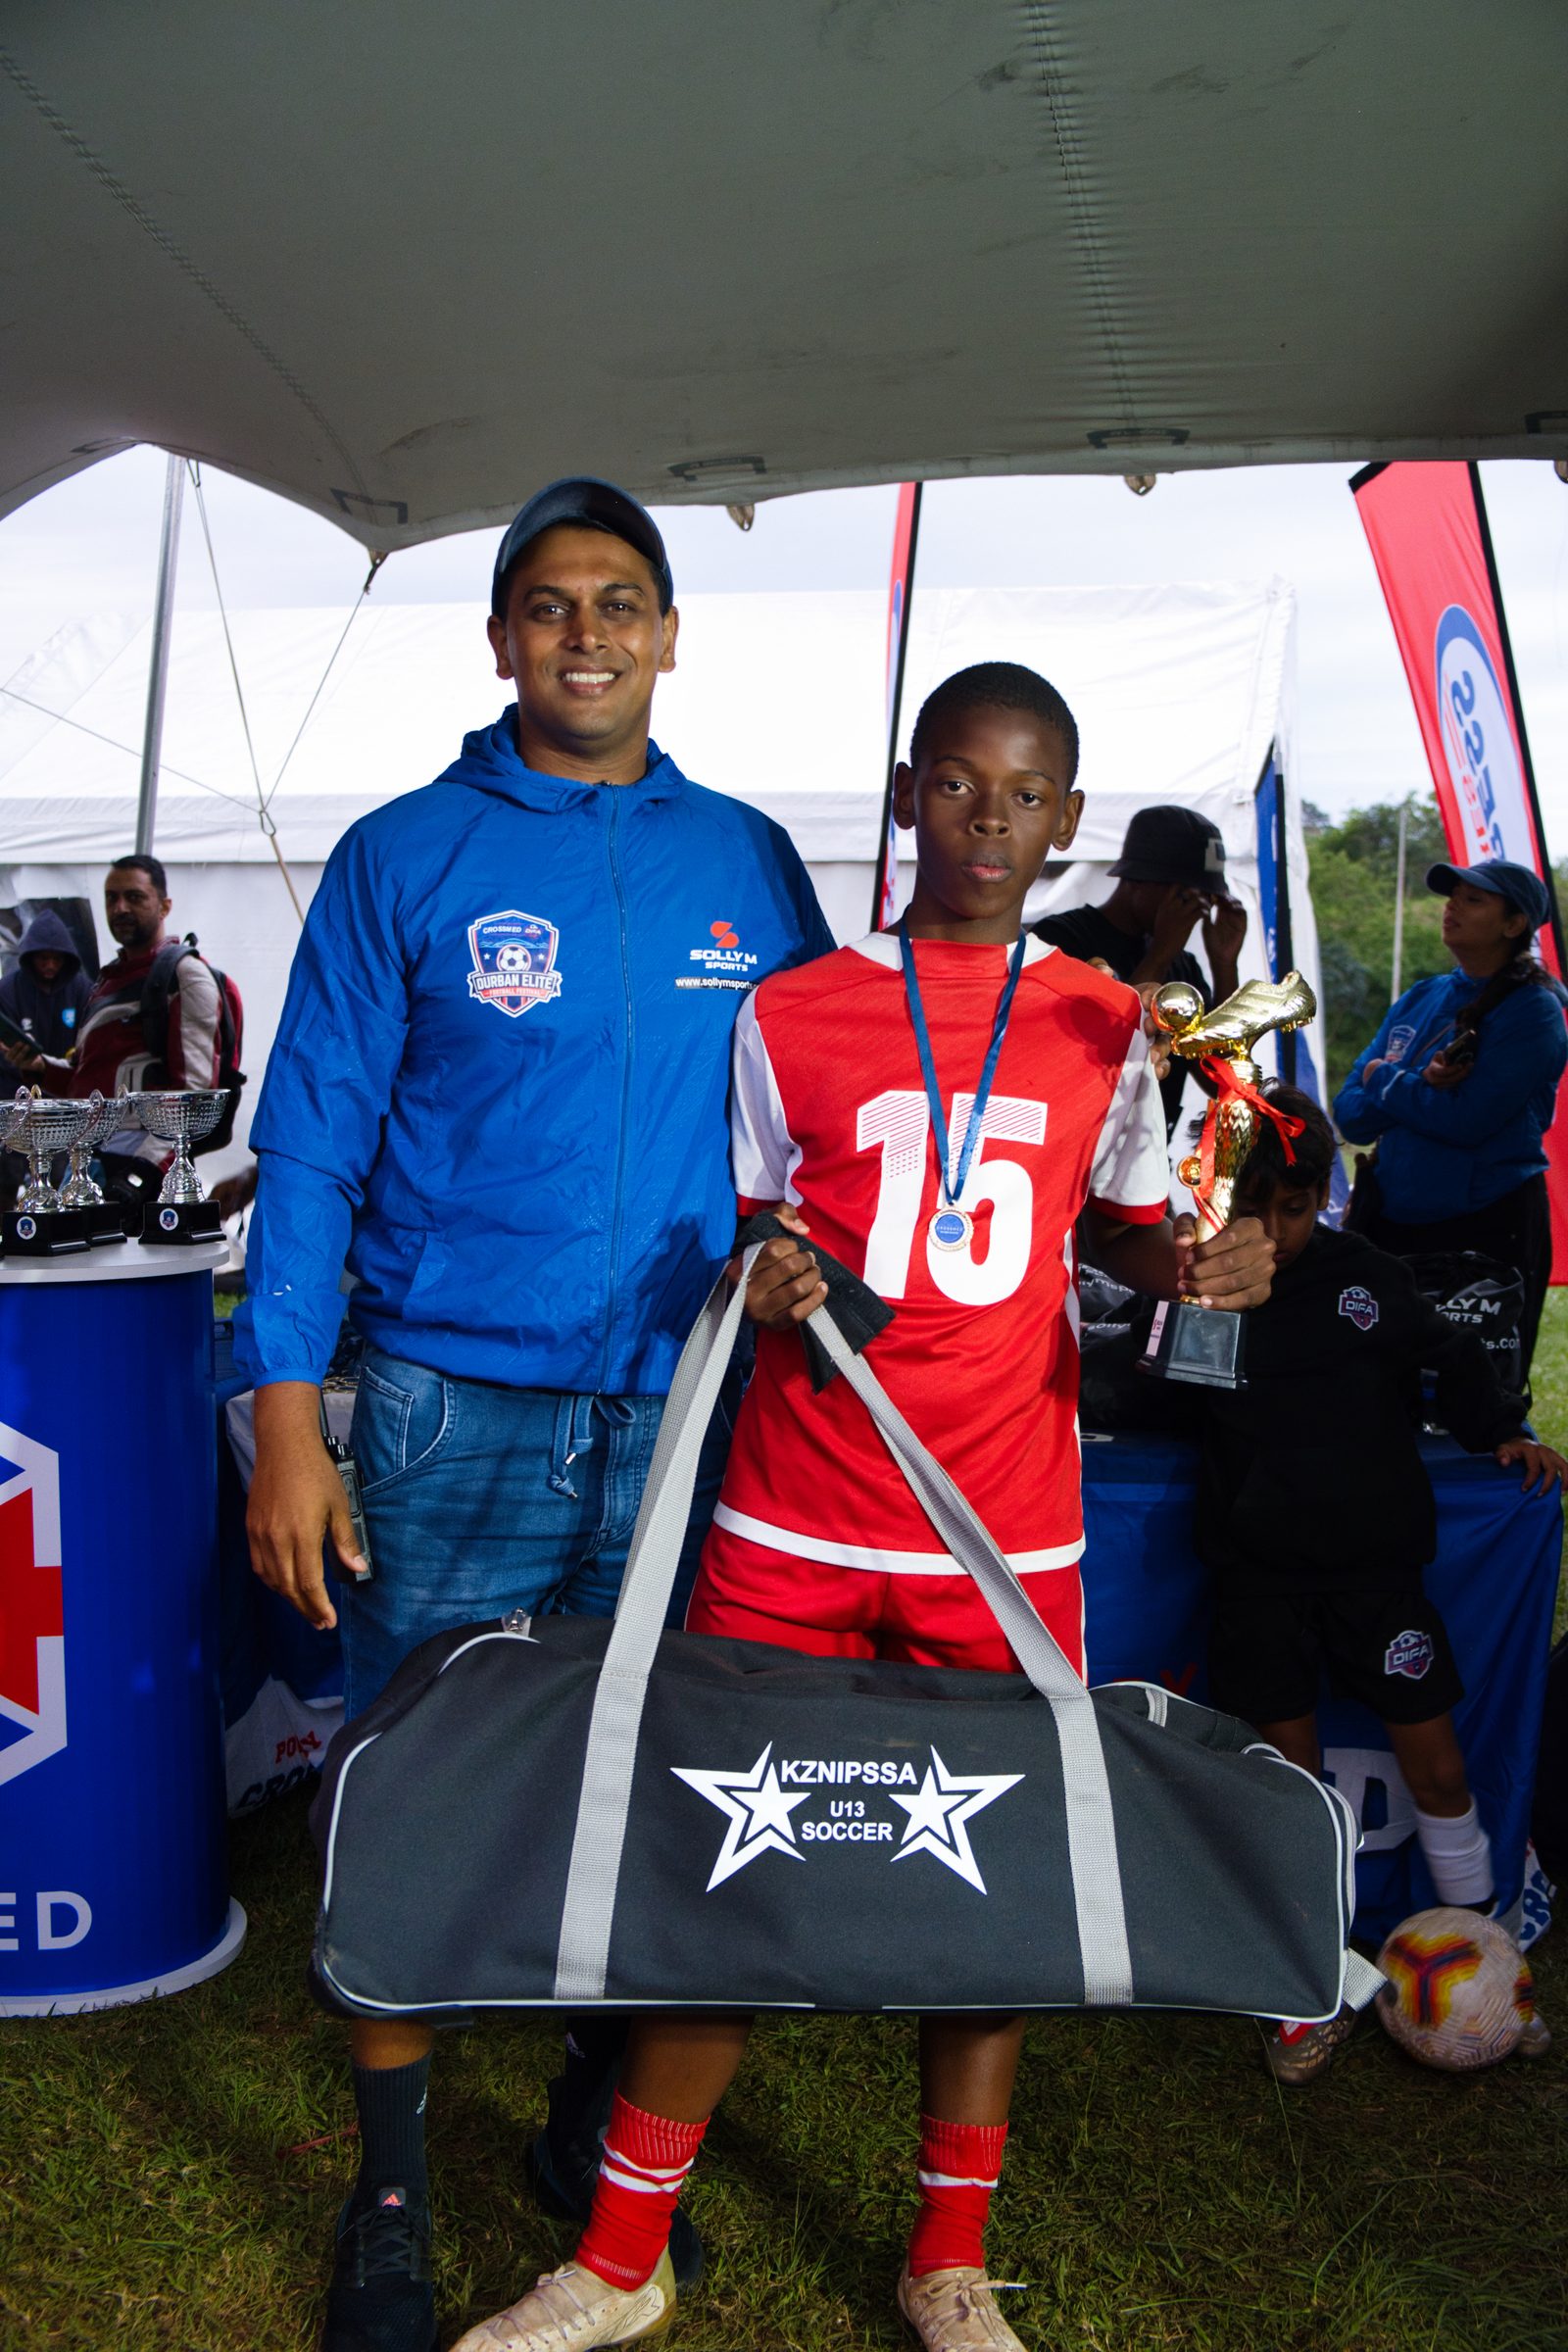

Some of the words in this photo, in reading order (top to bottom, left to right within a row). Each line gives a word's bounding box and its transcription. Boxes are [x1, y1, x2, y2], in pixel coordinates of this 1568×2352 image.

[483, 925, 521, 934] CROSSMED
[690, 949, 744, 962] SOLLY
[745, 953, 758, 964] M
[705, 961, 749, 972] SPORTS
[476, 974, 519, 990] DURBAN
[521, 974, 554, 990] ELITE
[857, 1090, 1048, 1306] 15
[1346, 1300, 1374, 1315] DIFA
[1480, 1298, 1501, 1315] M
[1394, 1645, 1428, 1665] DIFA
[781, 1760, 917, 1785] KZNIPSSA
[830, 1801, 865, 1817] U13
[801, 1823, 893, 1841] SOCCER
